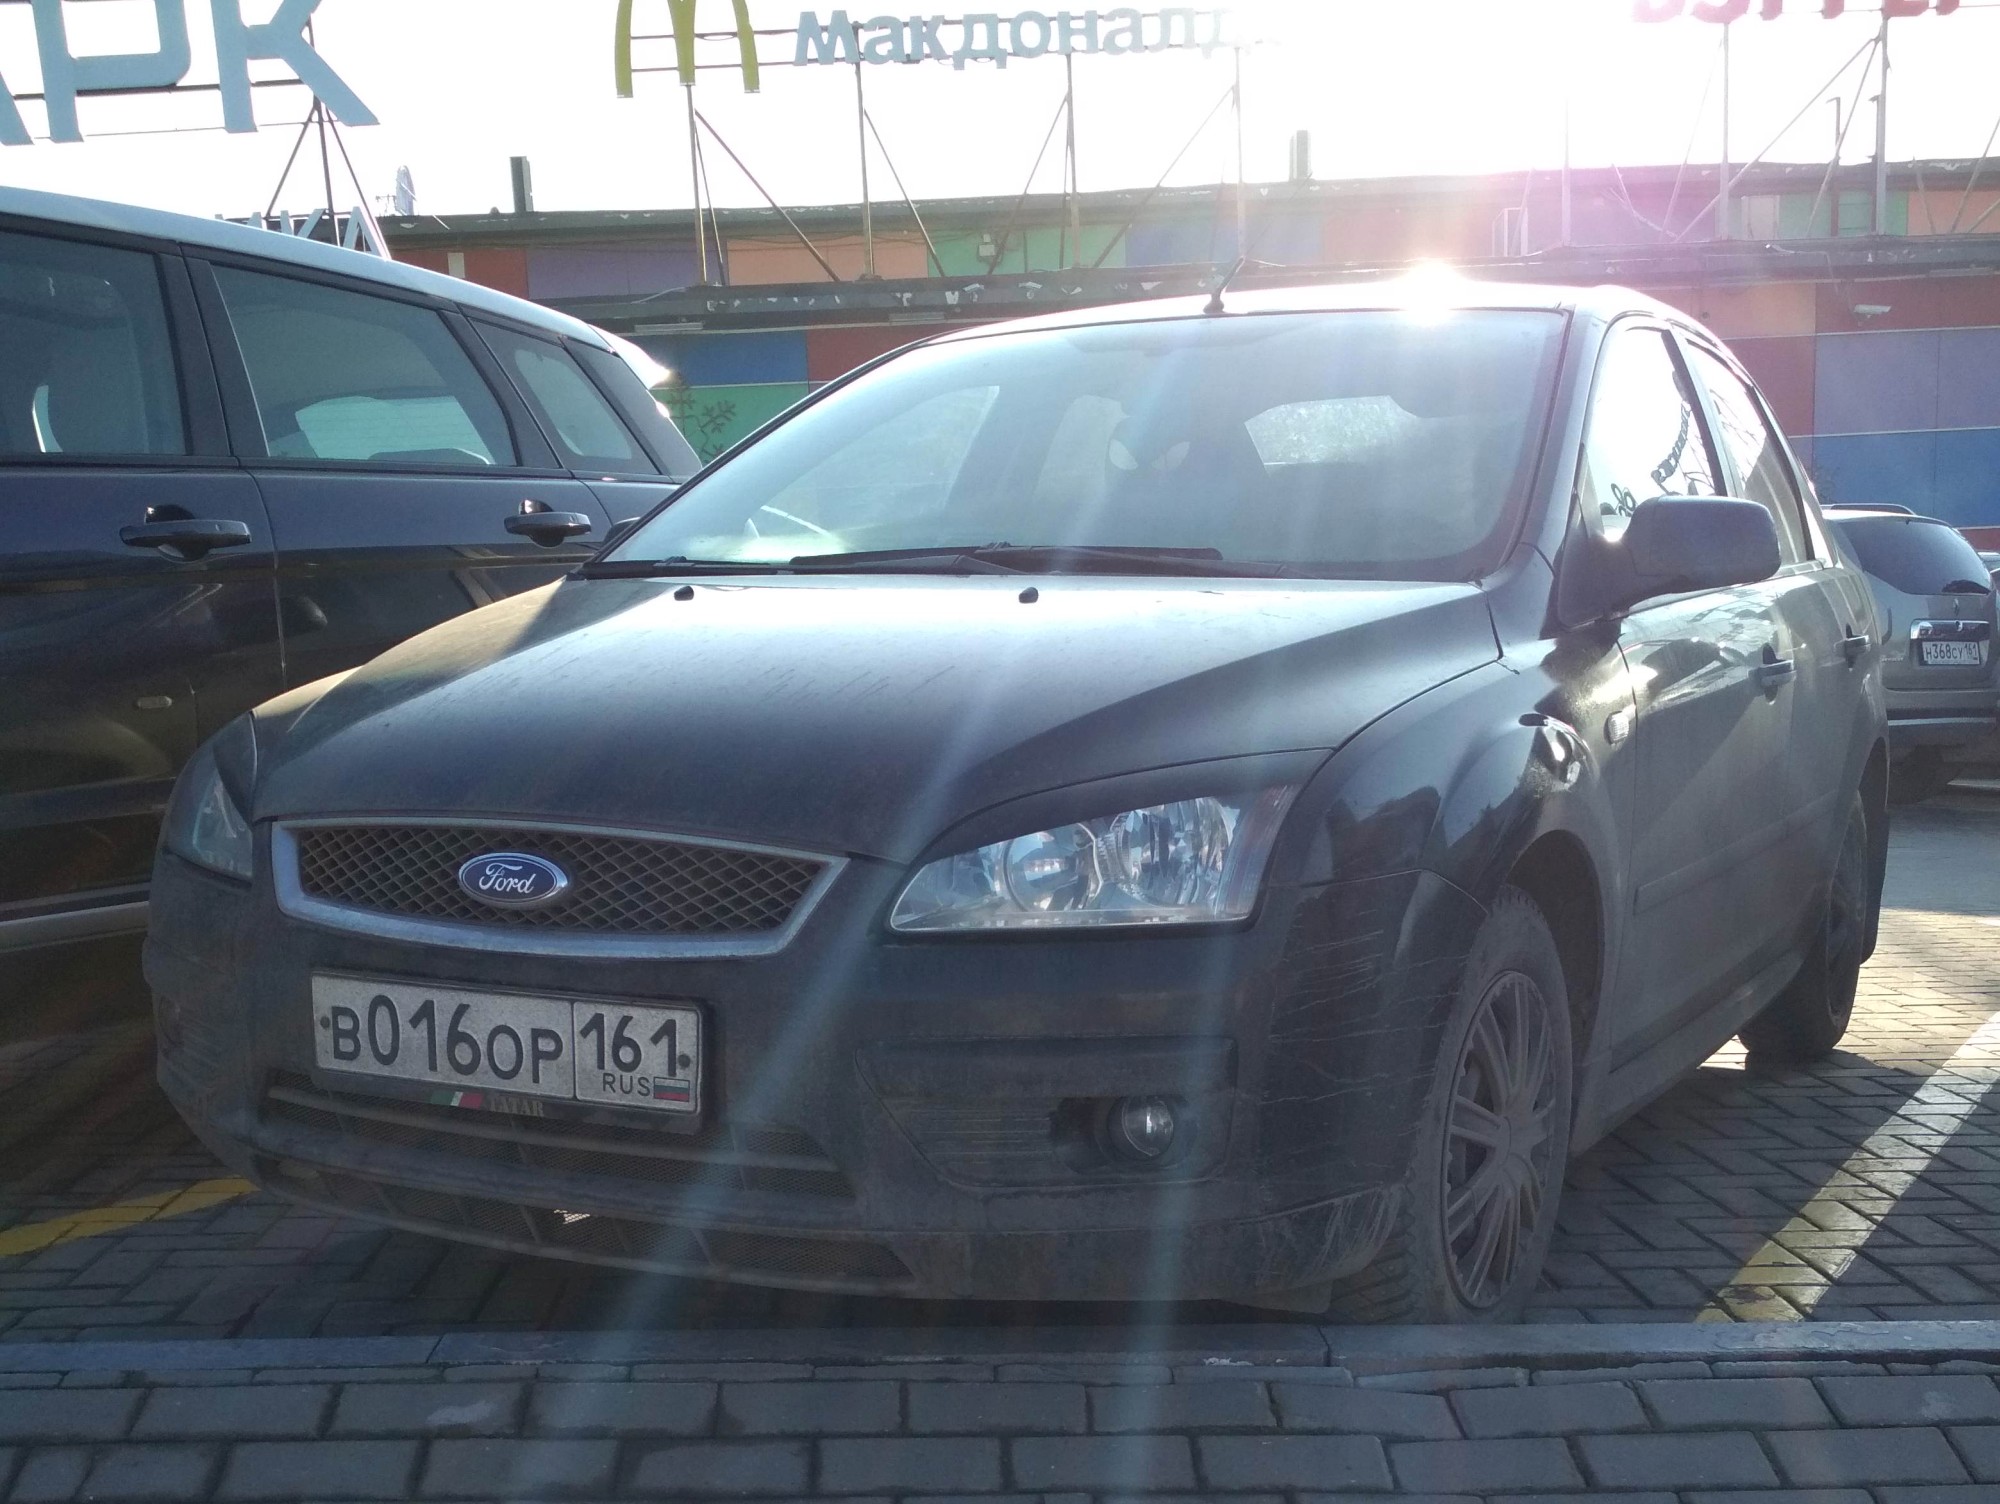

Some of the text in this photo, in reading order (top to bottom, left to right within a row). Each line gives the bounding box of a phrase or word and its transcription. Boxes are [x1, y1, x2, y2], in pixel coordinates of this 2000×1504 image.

[794, 6, 1250, 70] Макдоналд
[0, 0, 381, 146] РК
[478, 862, 537, 894] Ford
[331, 994, 678, 1084] В016ОР 161
[602, 1072, 651, 1098] RUS
